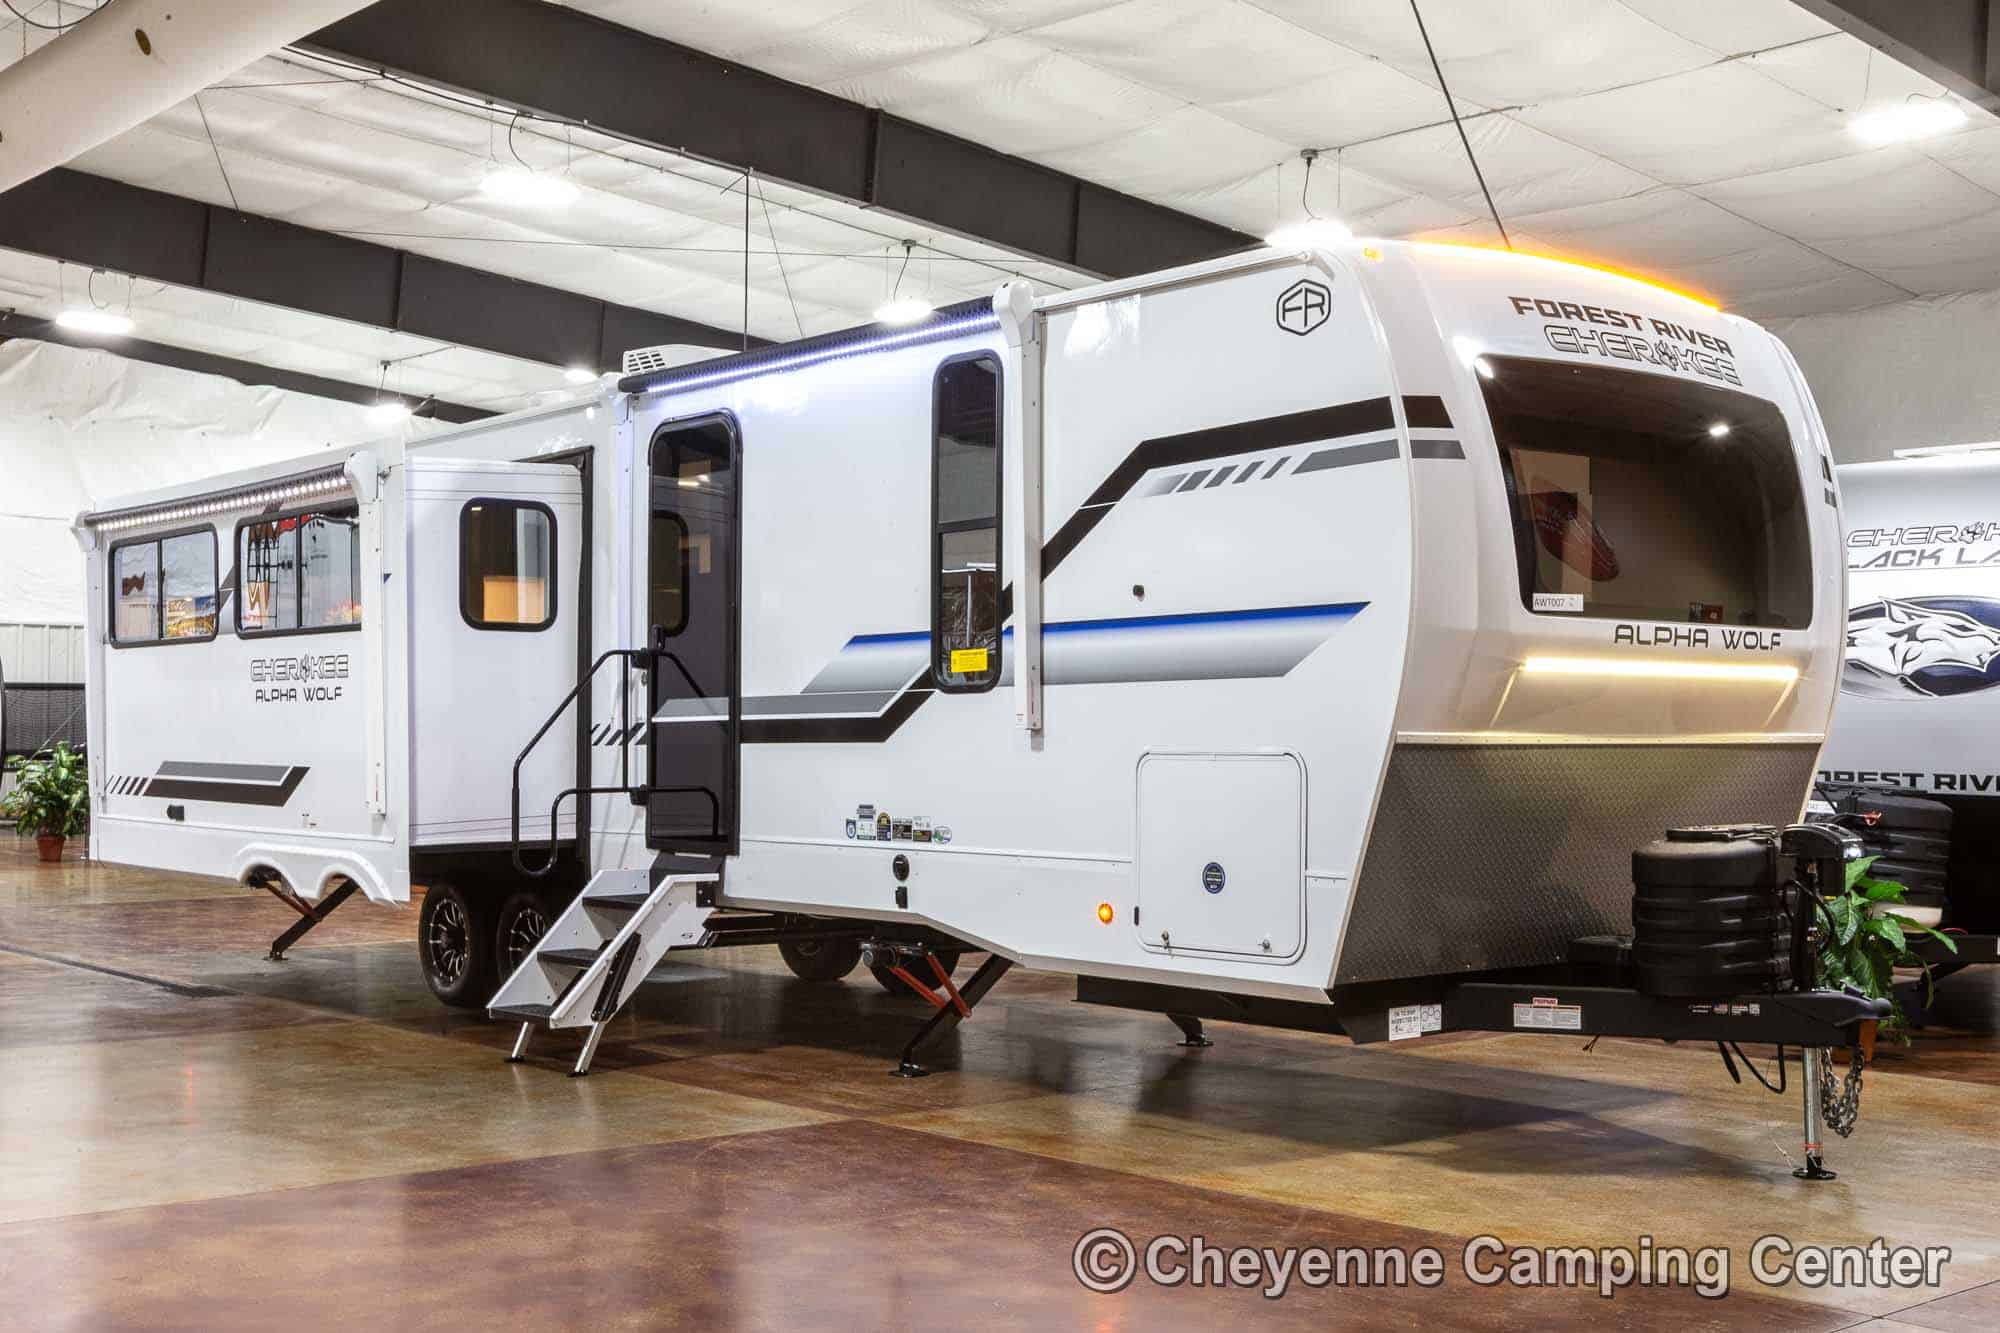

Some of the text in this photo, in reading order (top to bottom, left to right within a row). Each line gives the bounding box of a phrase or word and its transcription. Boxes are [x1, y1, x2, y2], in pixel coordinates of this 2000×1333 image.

[1508, 295, 1734, 358] FOREST RIVER
[1543, 323, 1742, 386] CHEROKEE
[1614, 624, 1782, 650] ALPHA WOLF
[250, 653, 349, 682] CHEROKEE
[255, 686, 342, 703] ALPHA WOLF
[1933, 773, 2000, 791] RIV
